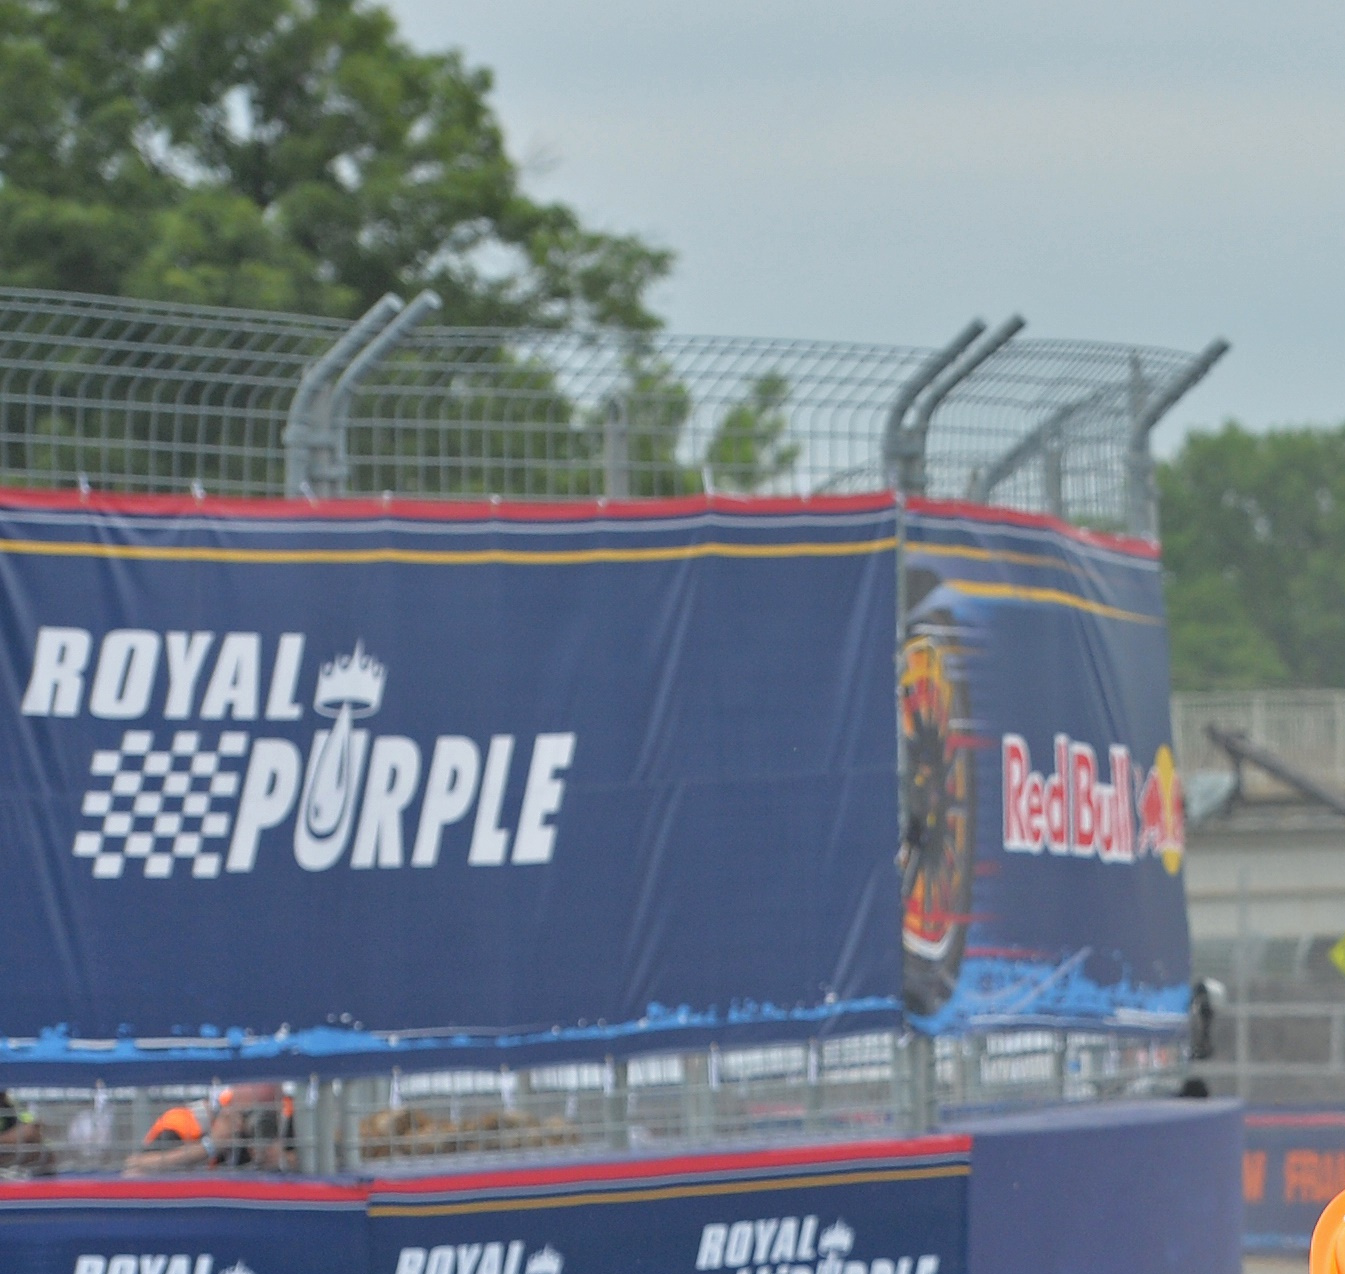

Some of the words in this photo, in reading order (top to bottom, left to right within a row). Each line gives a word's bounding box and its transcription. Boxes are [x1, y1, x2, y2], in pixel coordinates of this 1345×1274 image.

[21, 625, 305, 721] ROYAL
[226, 730, 577, 874] PURPLE
[1003, 733, 1069, 855] Red
[1069, 741, 1135, 863] Bull
[695, 1214, 819, 1271] ROYAL
